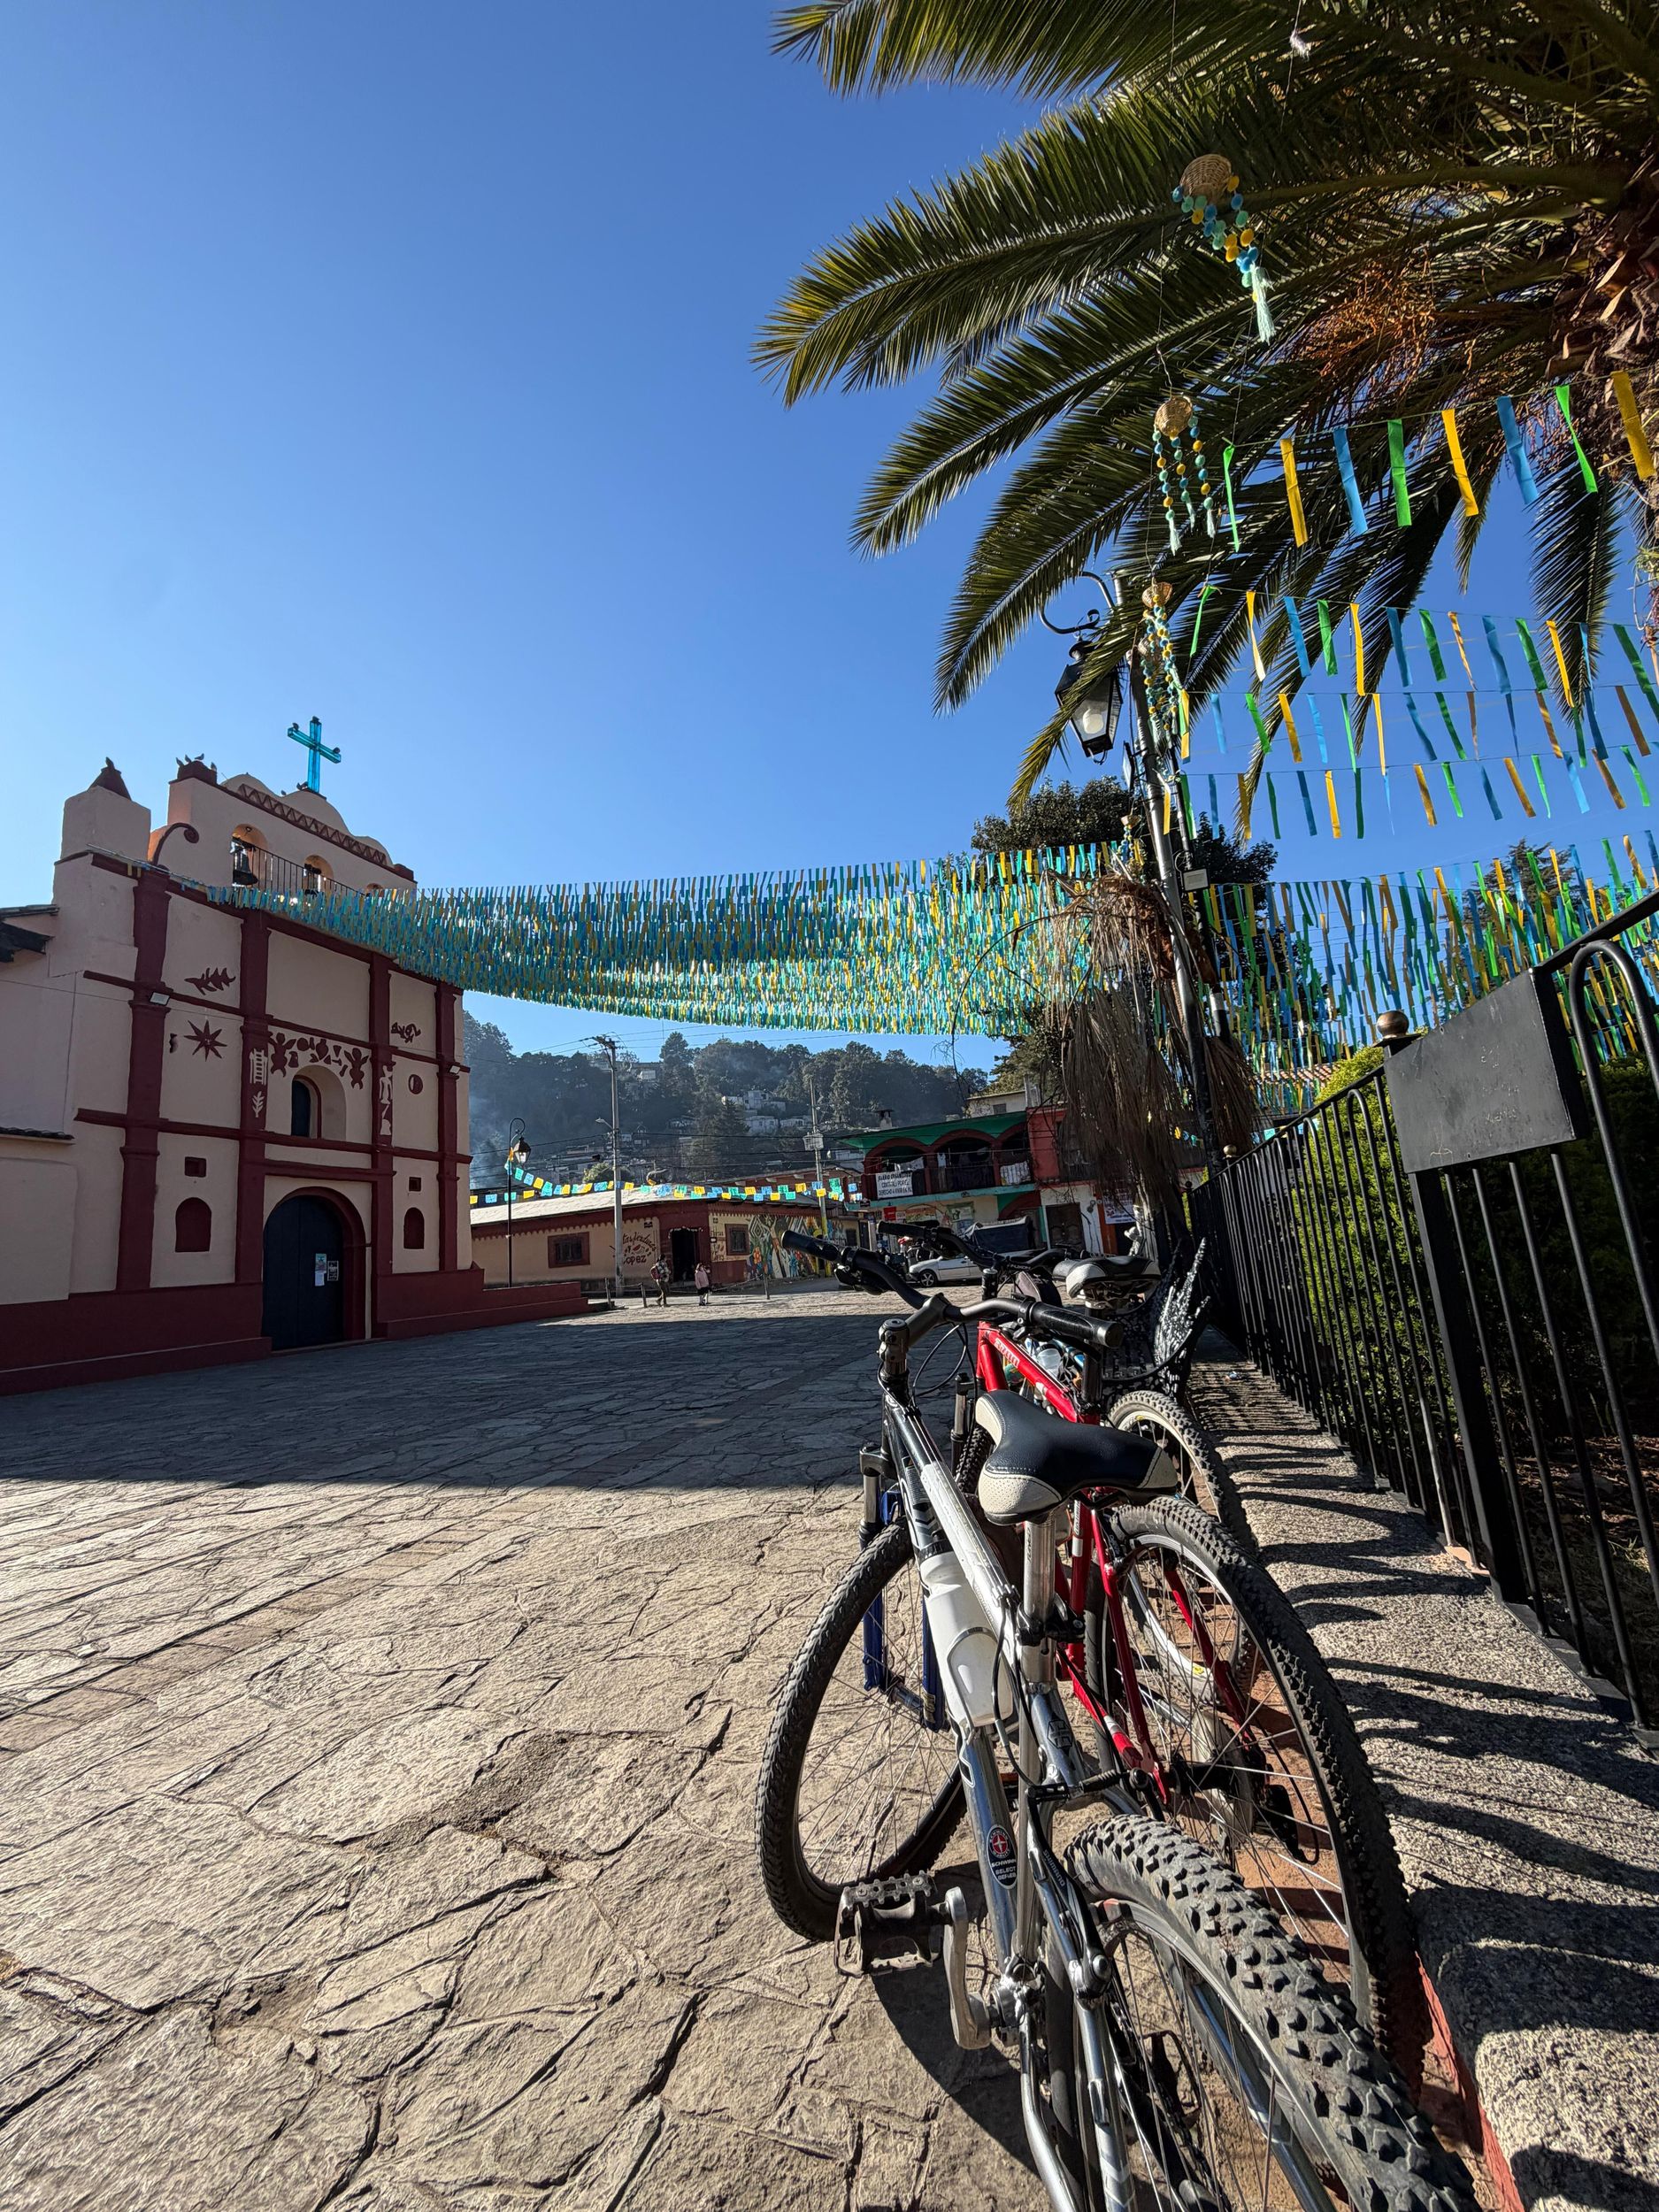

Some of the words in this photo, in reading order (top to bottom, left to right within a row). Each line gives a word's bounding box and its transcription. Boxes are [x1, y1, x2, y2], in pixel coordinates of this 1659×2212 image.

[623, 1256, 646, 1265] opez
[991, 1859, 1017, 1868] SCHWINN
[995, 1867, 1016, 1876] SELECT
